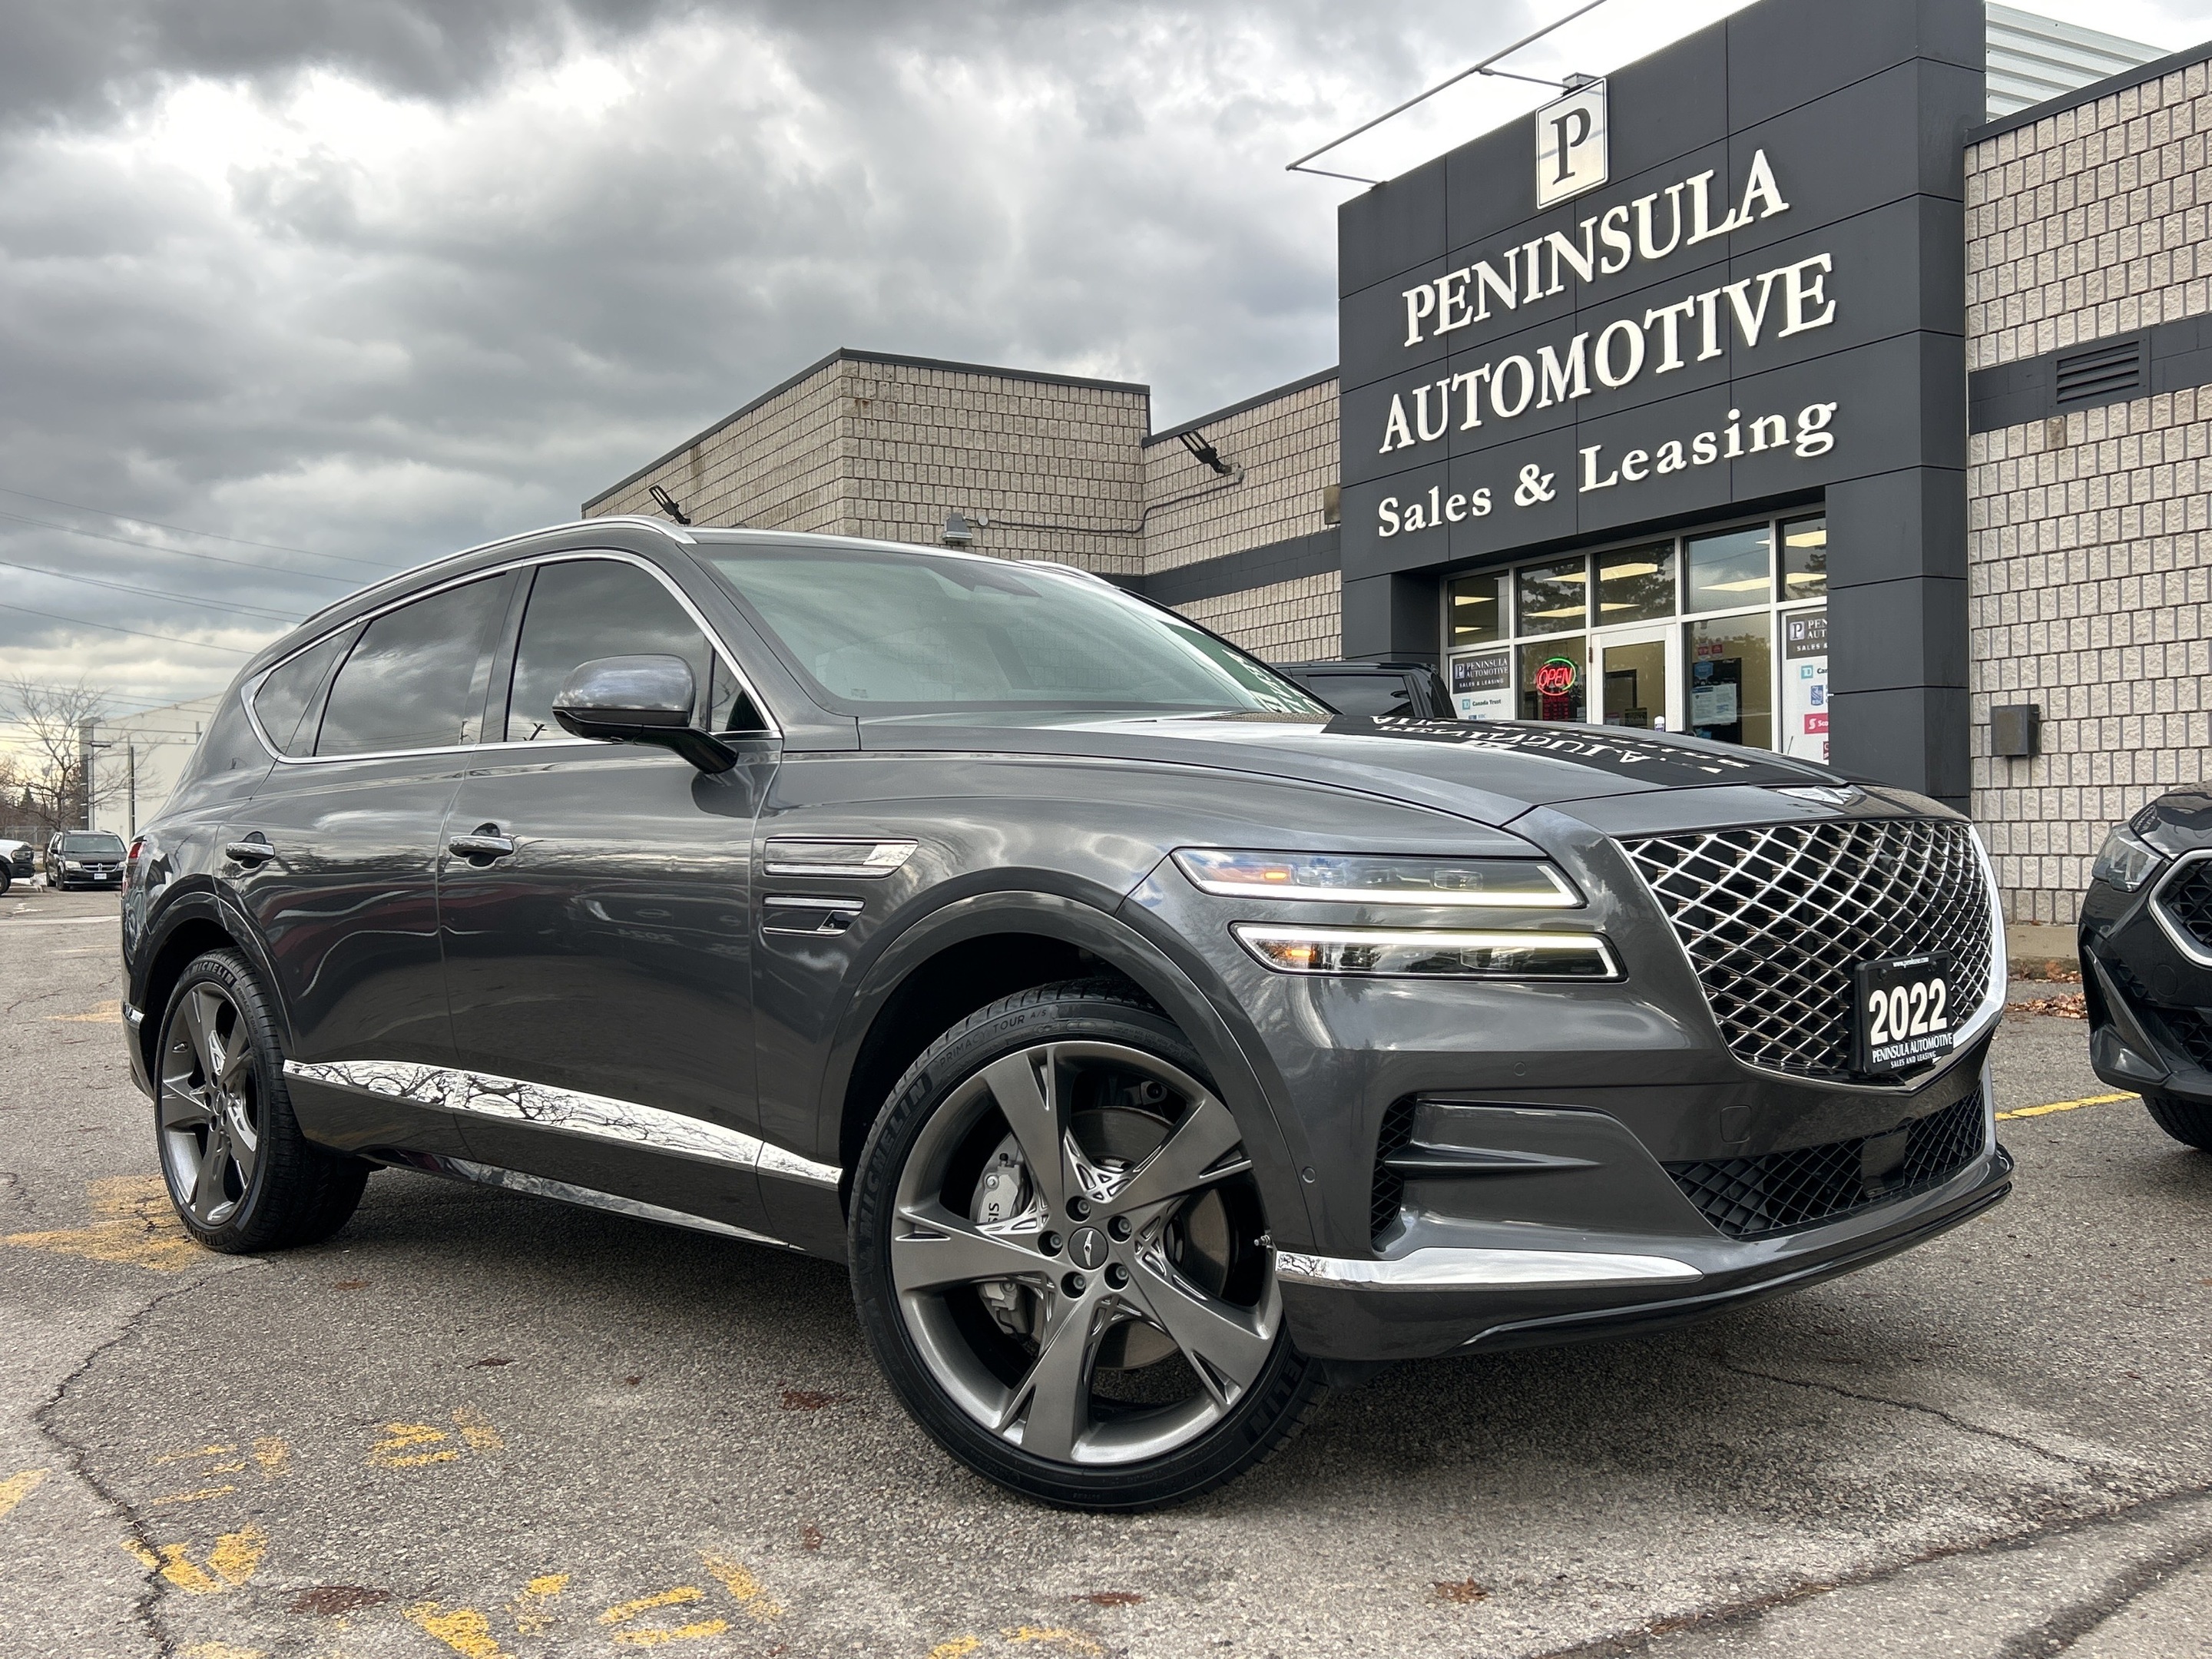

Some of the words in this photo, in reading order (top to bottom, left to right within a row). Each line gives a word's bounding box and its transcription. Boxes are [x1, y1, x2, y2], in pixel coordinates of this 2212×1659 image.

[1550, 106, 1591, 187] P
[1402, 148, 1790, 348] PENINSULA
[1378, 252, 1837, 455] AUTOMOTIVE
[1378, 484, 1492, 538] Sales
[1515, 462, 1557, 508] &
[1578, 401, 1839, 493] Leasing
[1796, 643, 1820, 652] SALES
[1465, 658, 1508, 671] PENINSULA
[1465, 667, 1508, 678] AUTOMOTIVE
[1538, 667, 1572, 687] OPEN
[1481, 677, 1504, 686] LEASING
[190, 962, 234, 985] MICHELIN
[1869, 978, 1948, 1046] 2022
[939, 1031, 987, 1068] PRIMACY
[992, 1015, 1025, 1033] TOUR
[1030, 1008, 1048, 1019] A/S
[1872, 1041, 1910, 1064] PENINSULA
[1909, 1032, 1953, 1055] AUTOMOTIVE
[1890, 1058, 1906, 1068] SALES
[1906, 1055, 1916, 1065] AND
[1917, 1050, 1937, 1061] LEASING
[859, 1071, 935, 1239] MICHELIN
